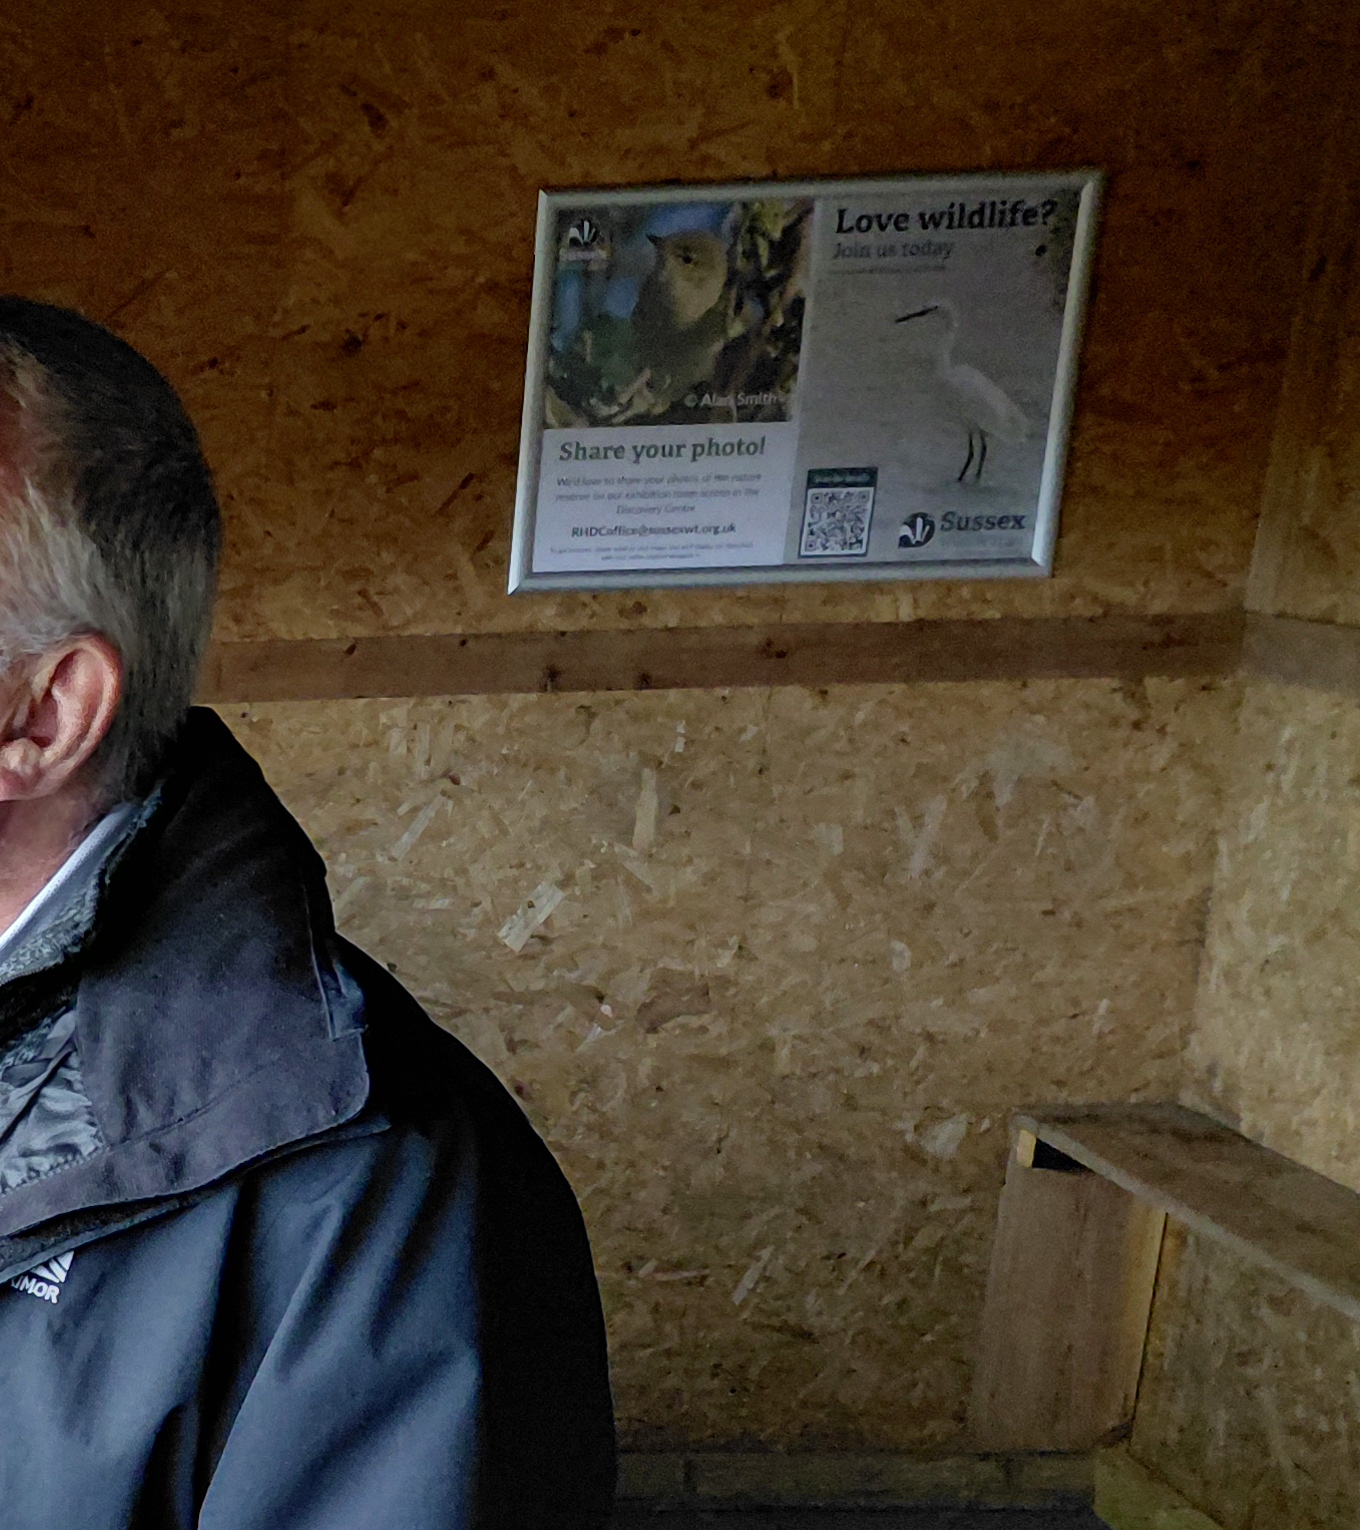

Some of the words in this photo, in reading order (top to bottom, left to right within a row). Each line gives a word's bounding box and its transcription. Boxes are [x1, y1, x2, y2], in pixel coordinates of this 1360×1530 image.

[835, 208, 910, 234] Love
[918, 199, 1057, 230] wildlife?
[559, 441, 625, 461] Share
[631, 443, 686, 464] your
[691, 436, 766, 462] photo!
[940, 510, 1026, 532] Sussex
